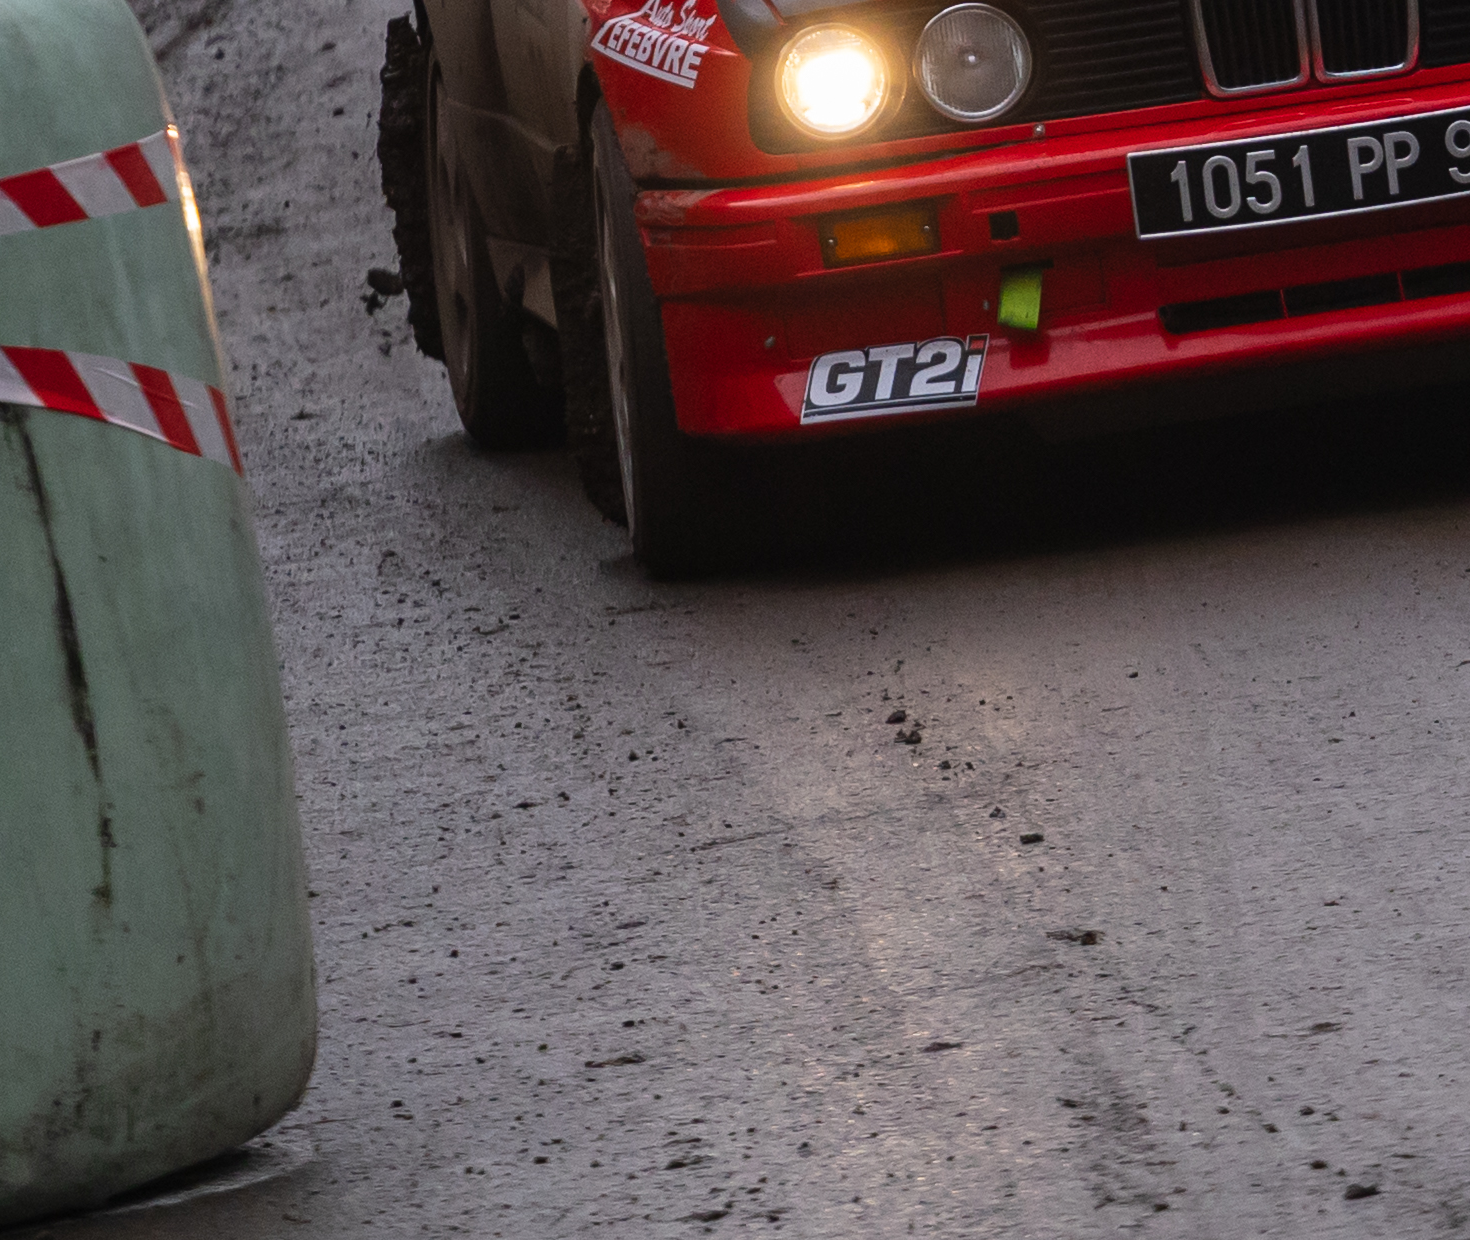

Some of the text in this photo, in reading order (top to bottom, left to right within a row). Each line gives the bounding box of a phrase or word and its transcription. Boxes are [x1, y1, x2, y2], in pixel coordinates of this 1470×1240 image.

[591, 17, 711, 89] LEFEBVRE
[1169, 144, 1316, 222] 1051
[1346, 130, 1420, 200] PP
[808, 337, 987, 407] GT2i
